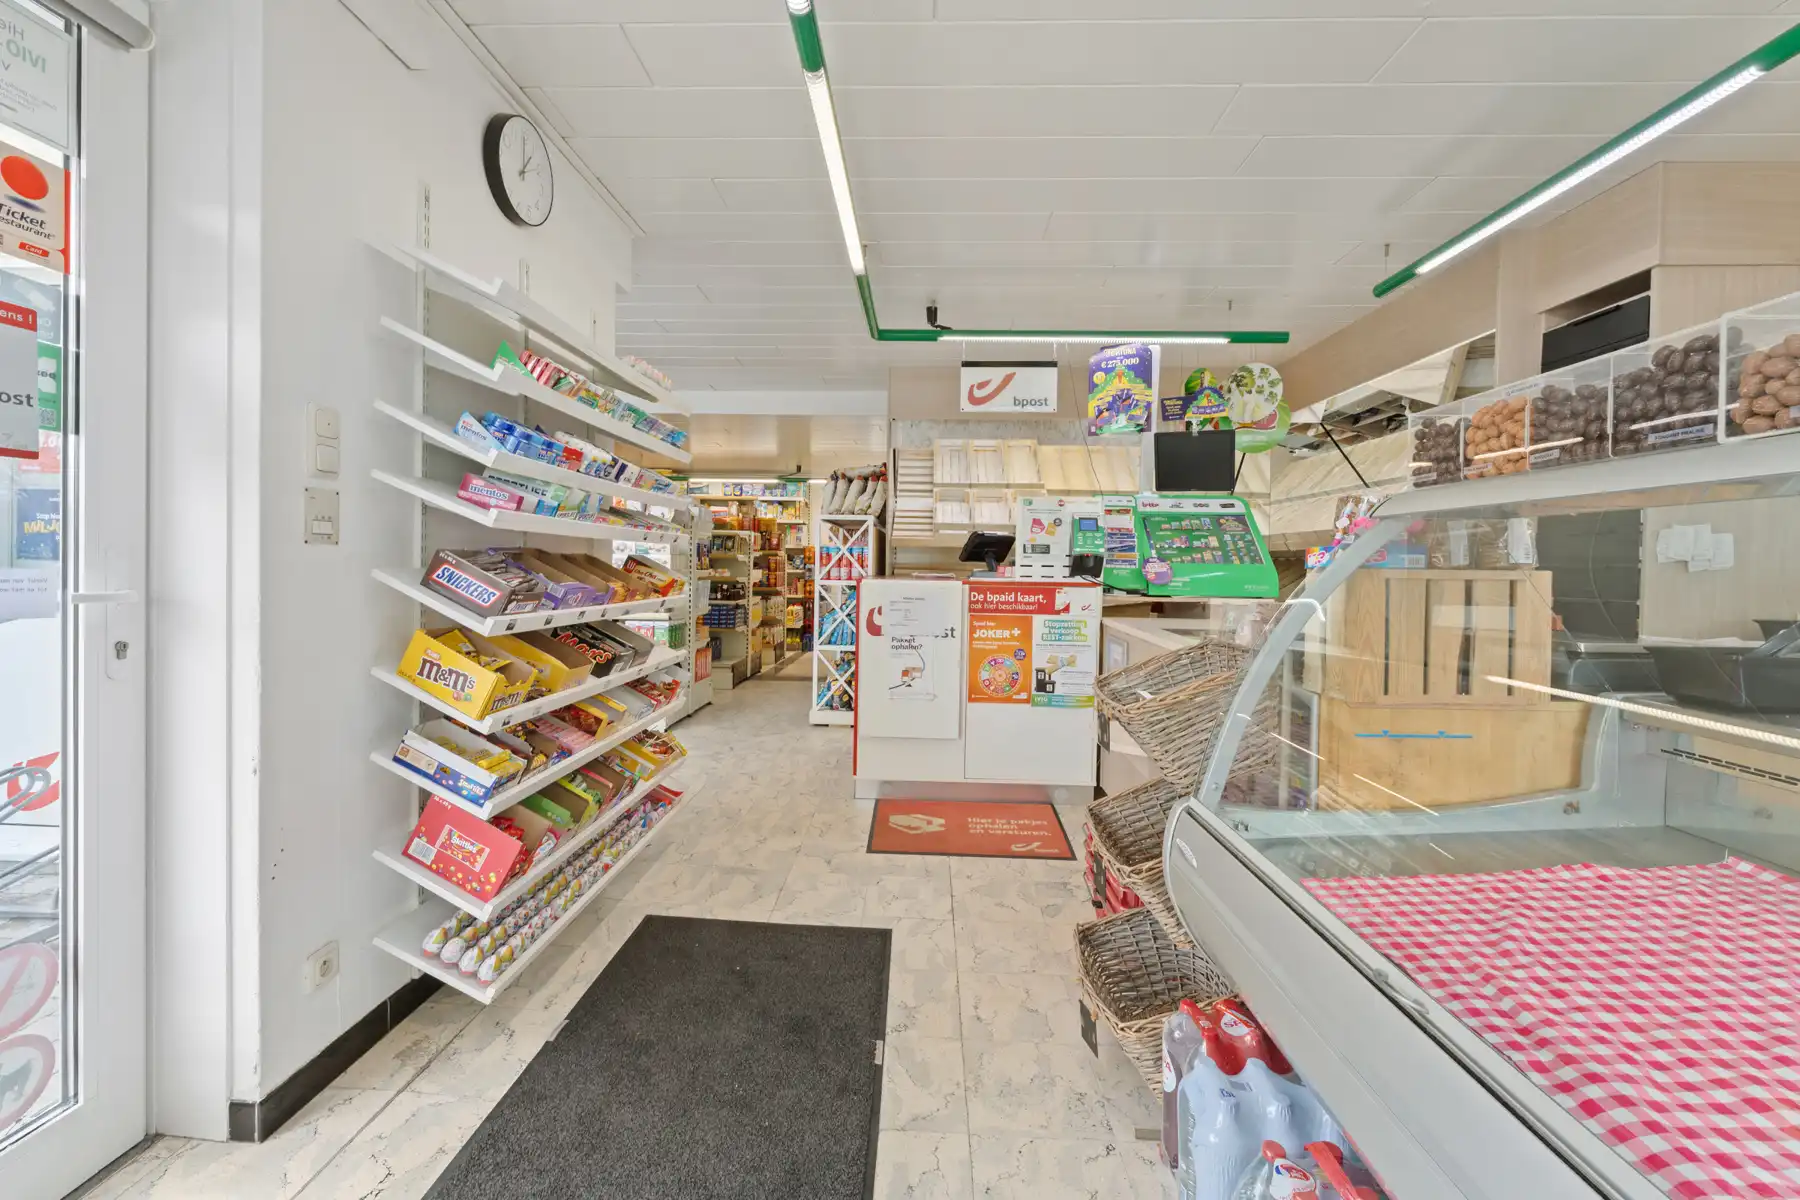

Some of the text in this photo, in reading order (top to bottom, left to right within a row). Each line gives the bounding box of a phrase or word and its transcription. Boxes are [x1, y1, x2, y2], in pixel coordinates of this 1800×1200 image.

[1013, 396, 1049, 409] bpost
[469, 483, 509, 500] mentos
[436, 566, 498, 605] SNICKERS
[970, 591, 1047, 604] De bpaid kaart,
[998, 603, 1038, 611] beschikbaar!
[968, 823, 1018, 831] ophalen
[451, 836, 477, 854] Skittles
